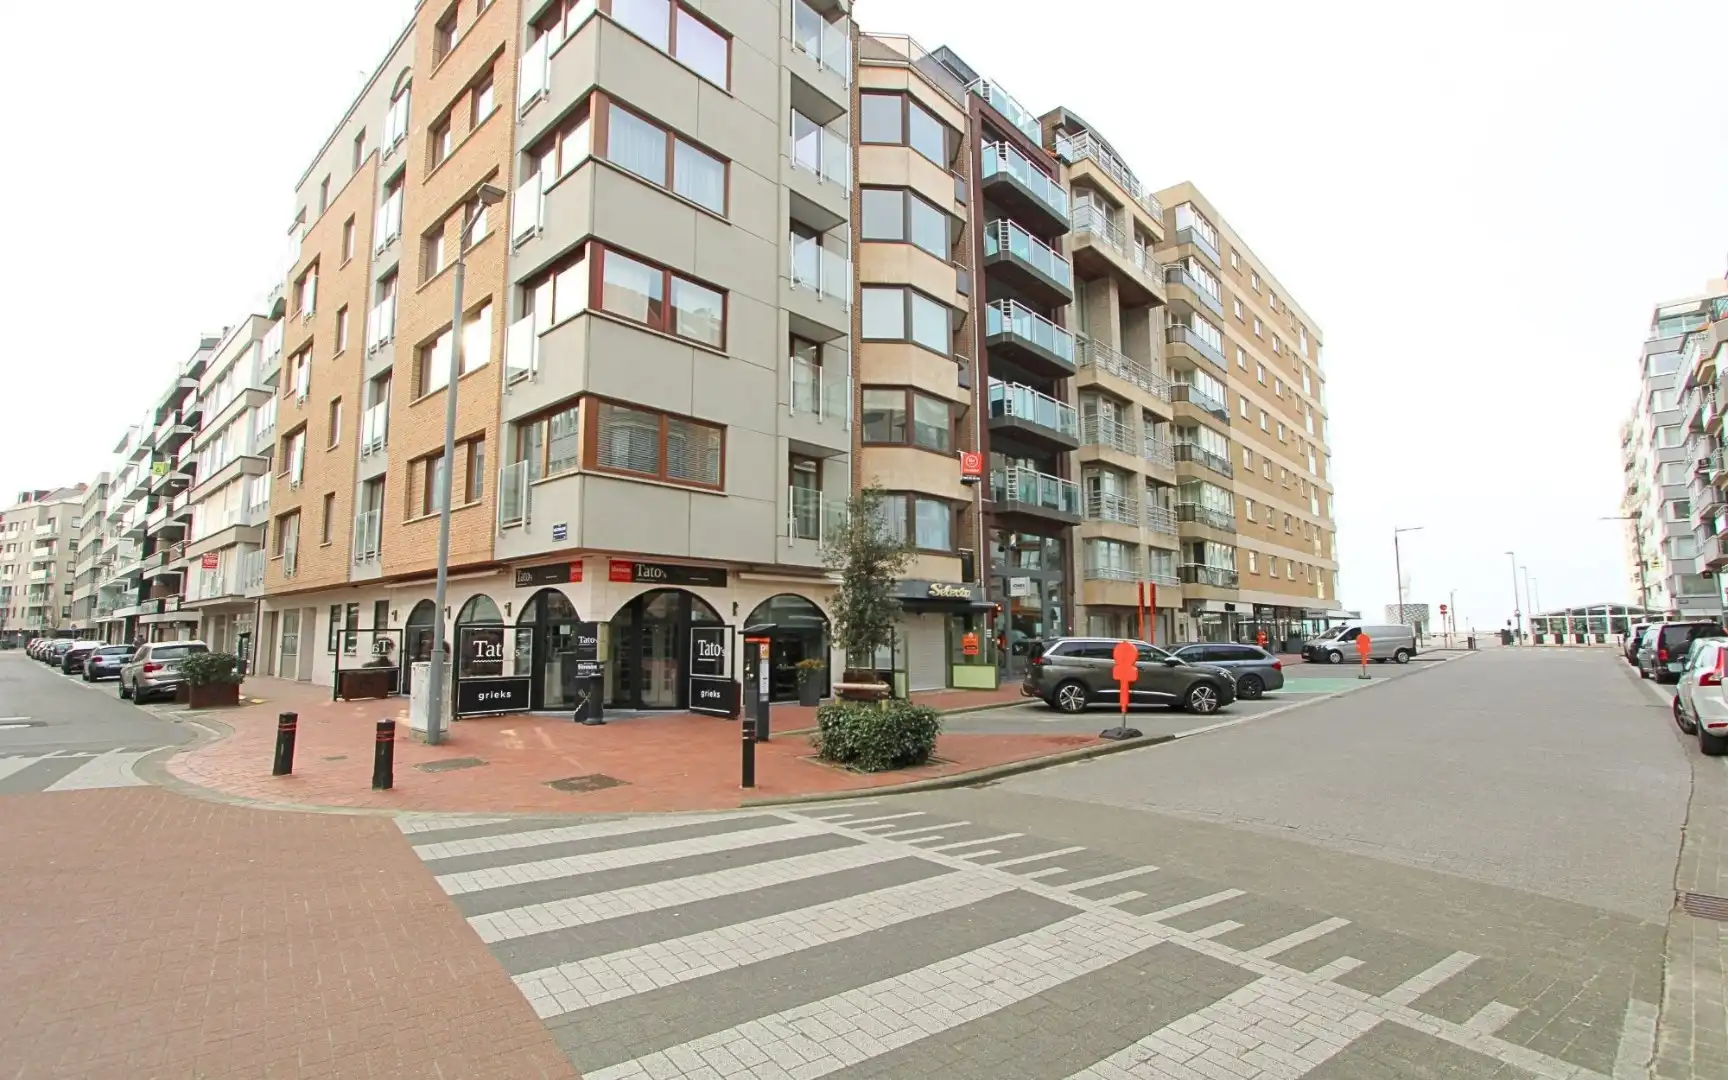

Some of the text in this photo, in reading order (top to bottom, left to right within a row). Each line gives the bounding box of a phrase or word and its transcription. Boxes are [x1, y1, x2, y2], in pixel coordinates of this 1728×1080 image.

[635, 564, 667, 579] Tato's
[478, 690, 512, 701] grieks
[700, 689, 721, 699] grieks
